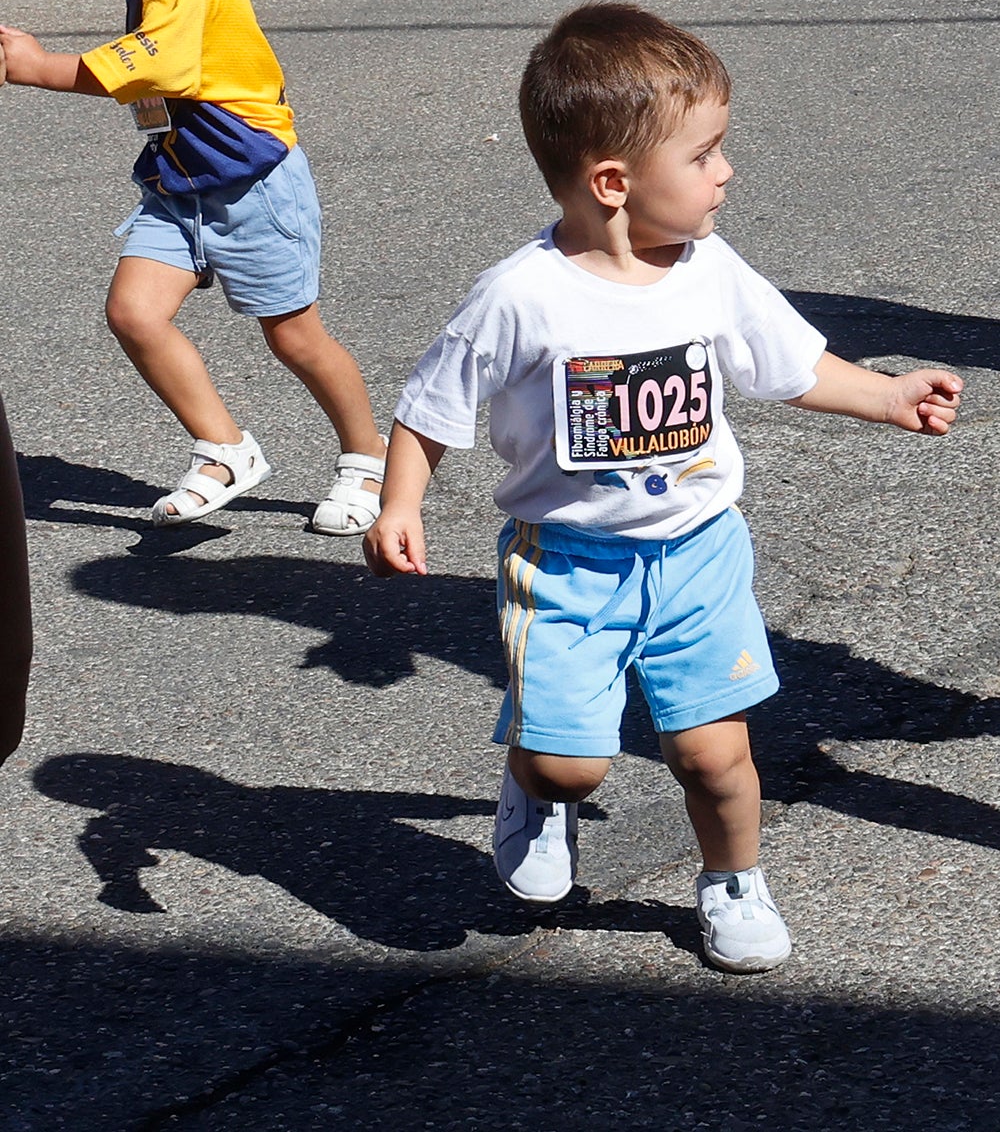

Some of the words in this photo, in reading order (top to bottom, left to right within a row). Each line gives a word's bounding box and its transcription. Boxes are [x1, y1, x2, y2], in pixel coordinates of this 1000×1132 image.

[584, 398, 595, 411] de
[595, 390, 608, 426] crónica
[614, 370, 708, 432] 1025
[596, 428, 610, 458] Fatiga
[609, 422, 710, 457] VILLALOBÓN
